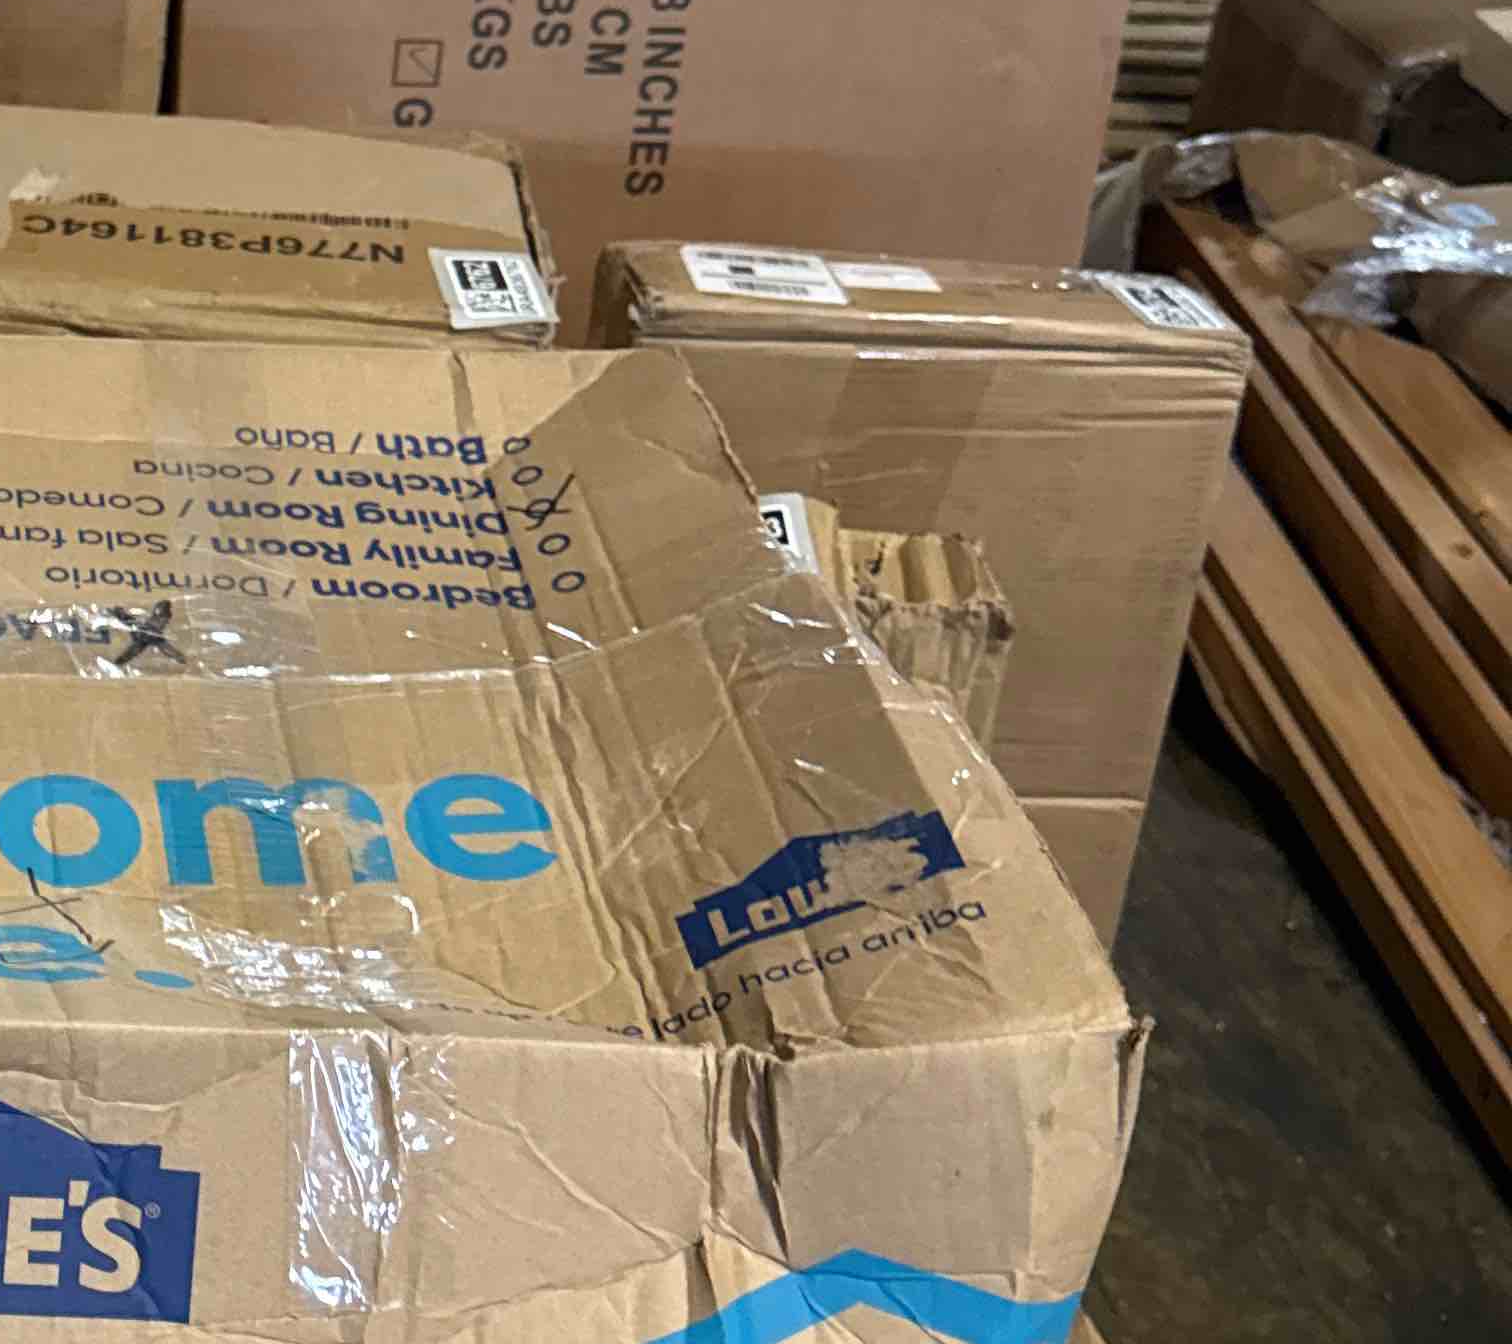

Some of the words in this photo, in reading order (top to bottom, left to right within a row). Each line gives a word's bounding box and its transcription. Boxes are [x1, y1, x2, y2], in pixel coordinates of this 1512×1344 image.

[585, 8, 632, 78] CM
[624, 26, 688, 197] INCHES
[22, 215, 404, 264] N776P381164C
[377, 432, 486, 466] Bath
[133, 458, 275, 486] Cocina
[317, 467, 496, 501] Kitchen
[209, 498, 345, 528] Room
[356, 499, 508, 537] Dining
[78, 526, 169, 555] Sala
[212, 533, 351, 565] Room
[364, 537, 522, 574] Family
[45, 564, 269, 598] Dormitorio
[311, 575, 538, 610] Bedroom
[738, 945, 850, 994] hacia
[862, 901, 987, 954] arriba
